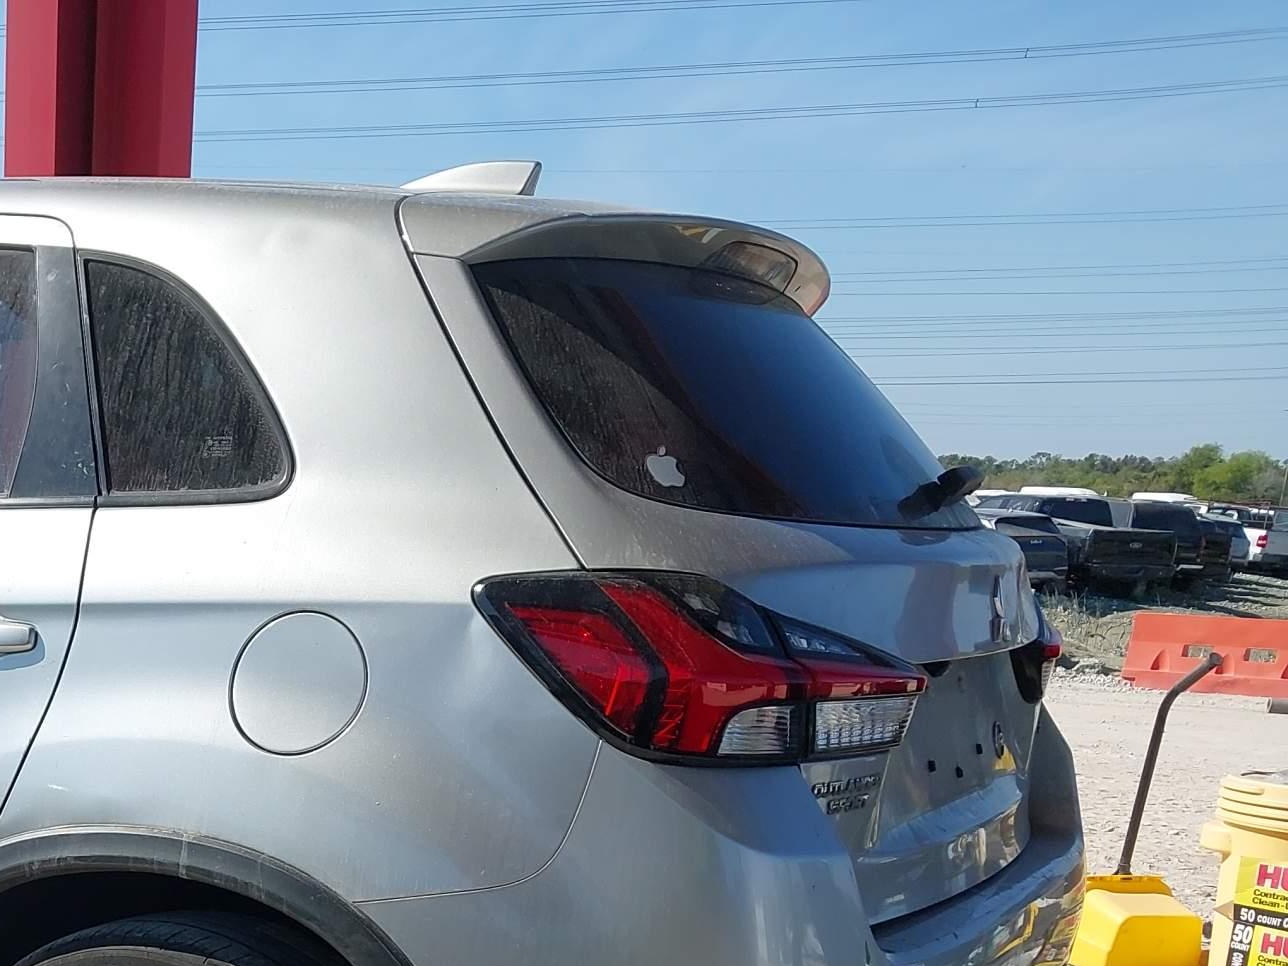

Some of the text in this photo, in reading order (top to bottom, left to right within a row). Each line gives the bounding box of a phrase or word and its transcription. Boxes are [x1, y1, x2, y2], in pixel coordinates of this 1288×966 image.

[1240, 907, 1255, 922] 50
[1257, 914, 1282, 927] COUNT
[1232, 923, 1253, 944] 50
[1231, 941, 1250, 952] COUNT
[1260, 932, 1288, 958] H
[1258, 954, 1288, 966] Contra
